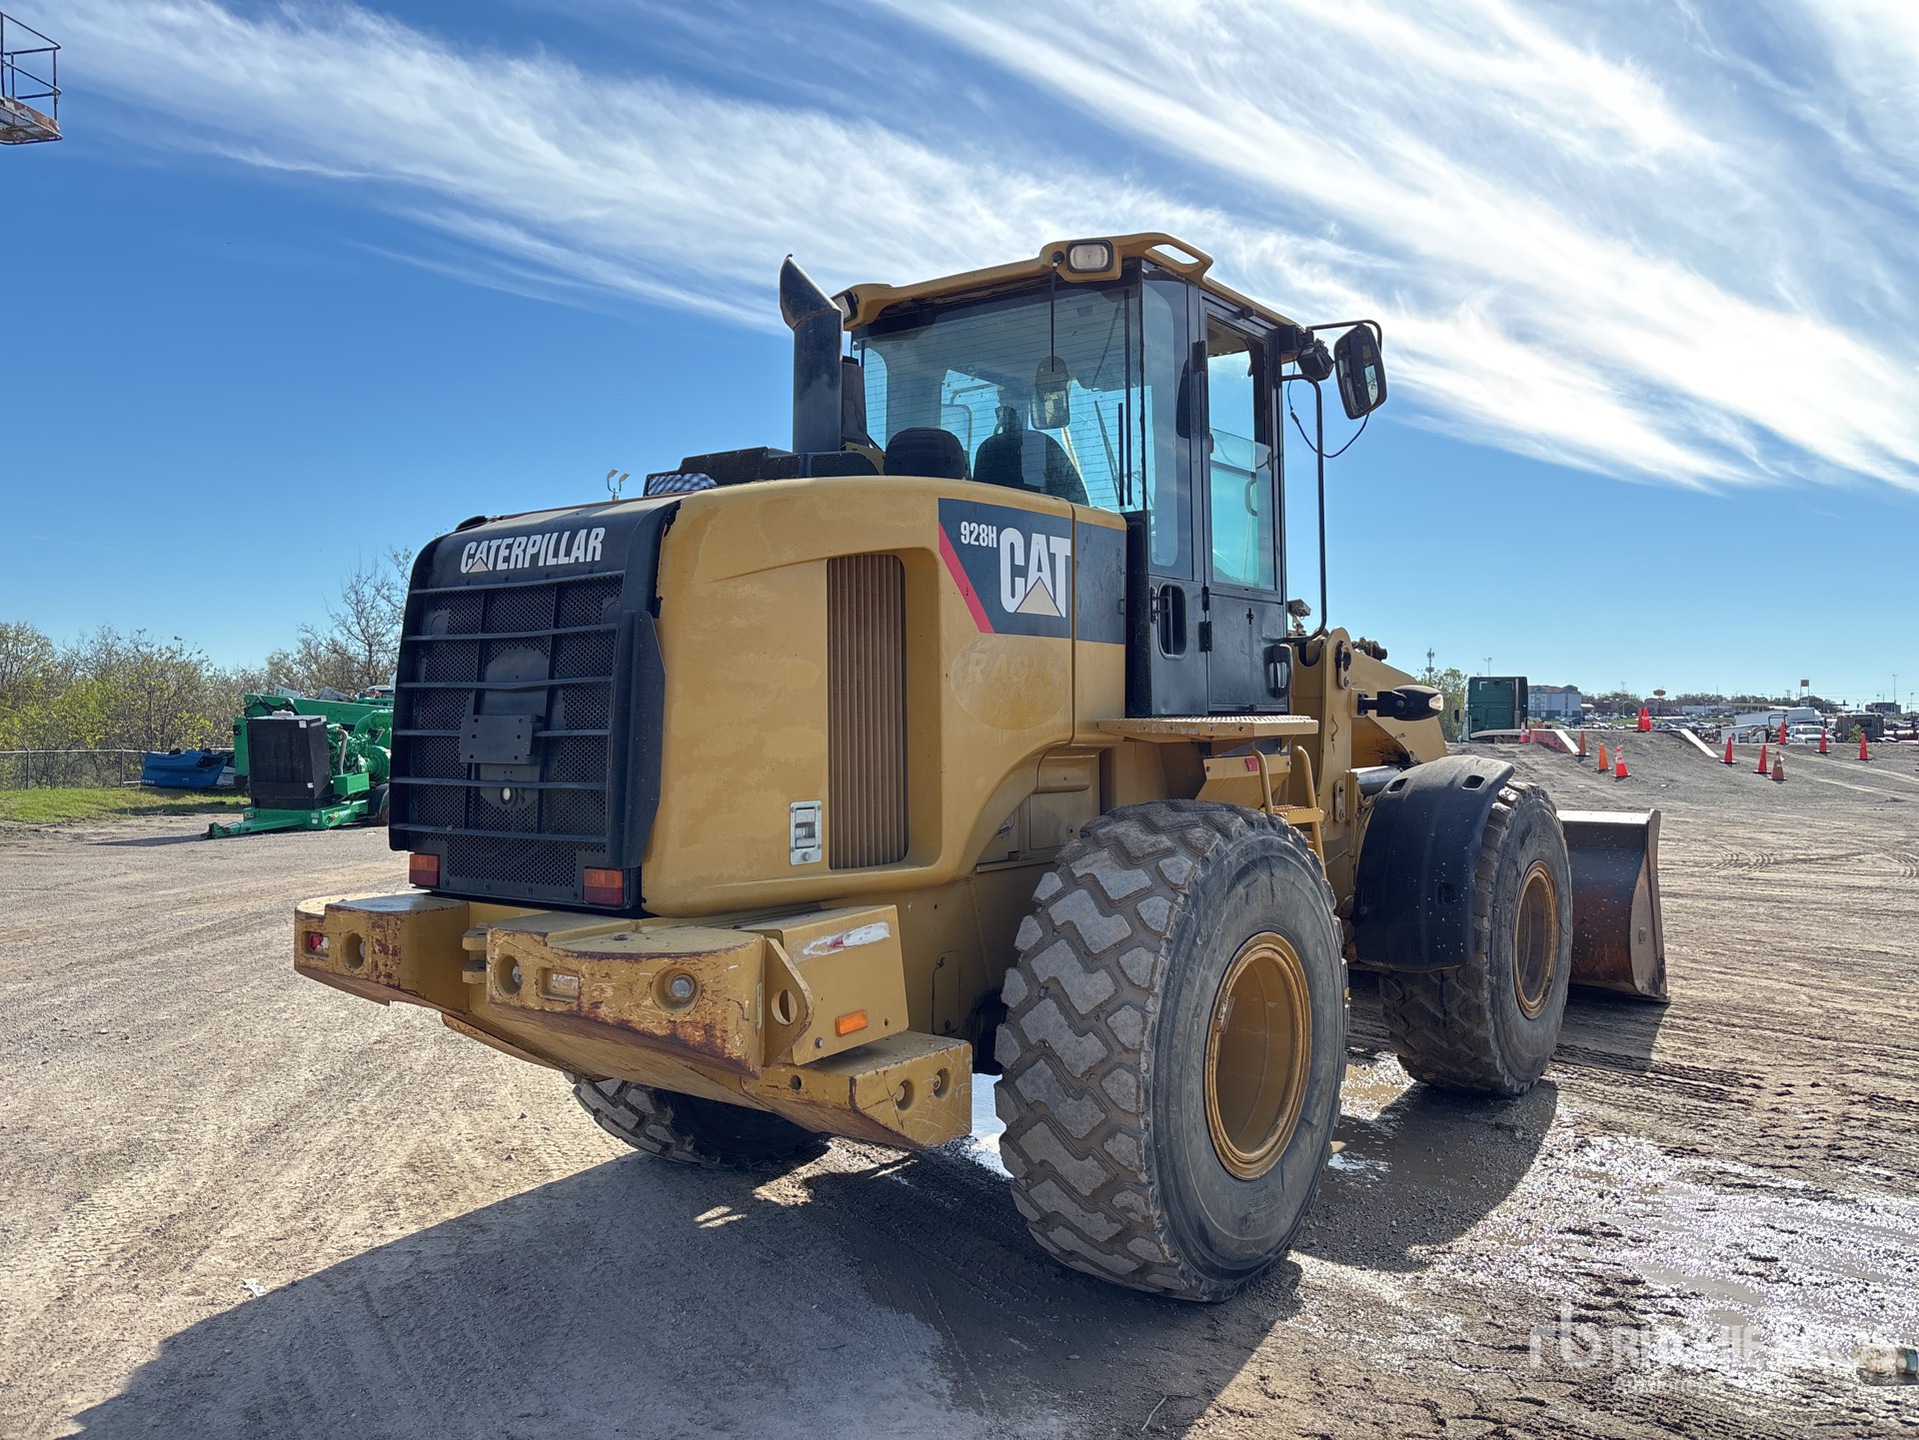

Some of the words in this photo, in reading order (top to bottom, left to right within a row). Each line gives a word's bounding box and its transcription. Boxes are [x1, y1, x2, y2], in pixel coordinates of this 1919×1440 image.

[460, 527, 605, 573] CATERPILLAR
[960, 521, 997, 548] 928H
[1000, 527, 1071, 618] CAT
